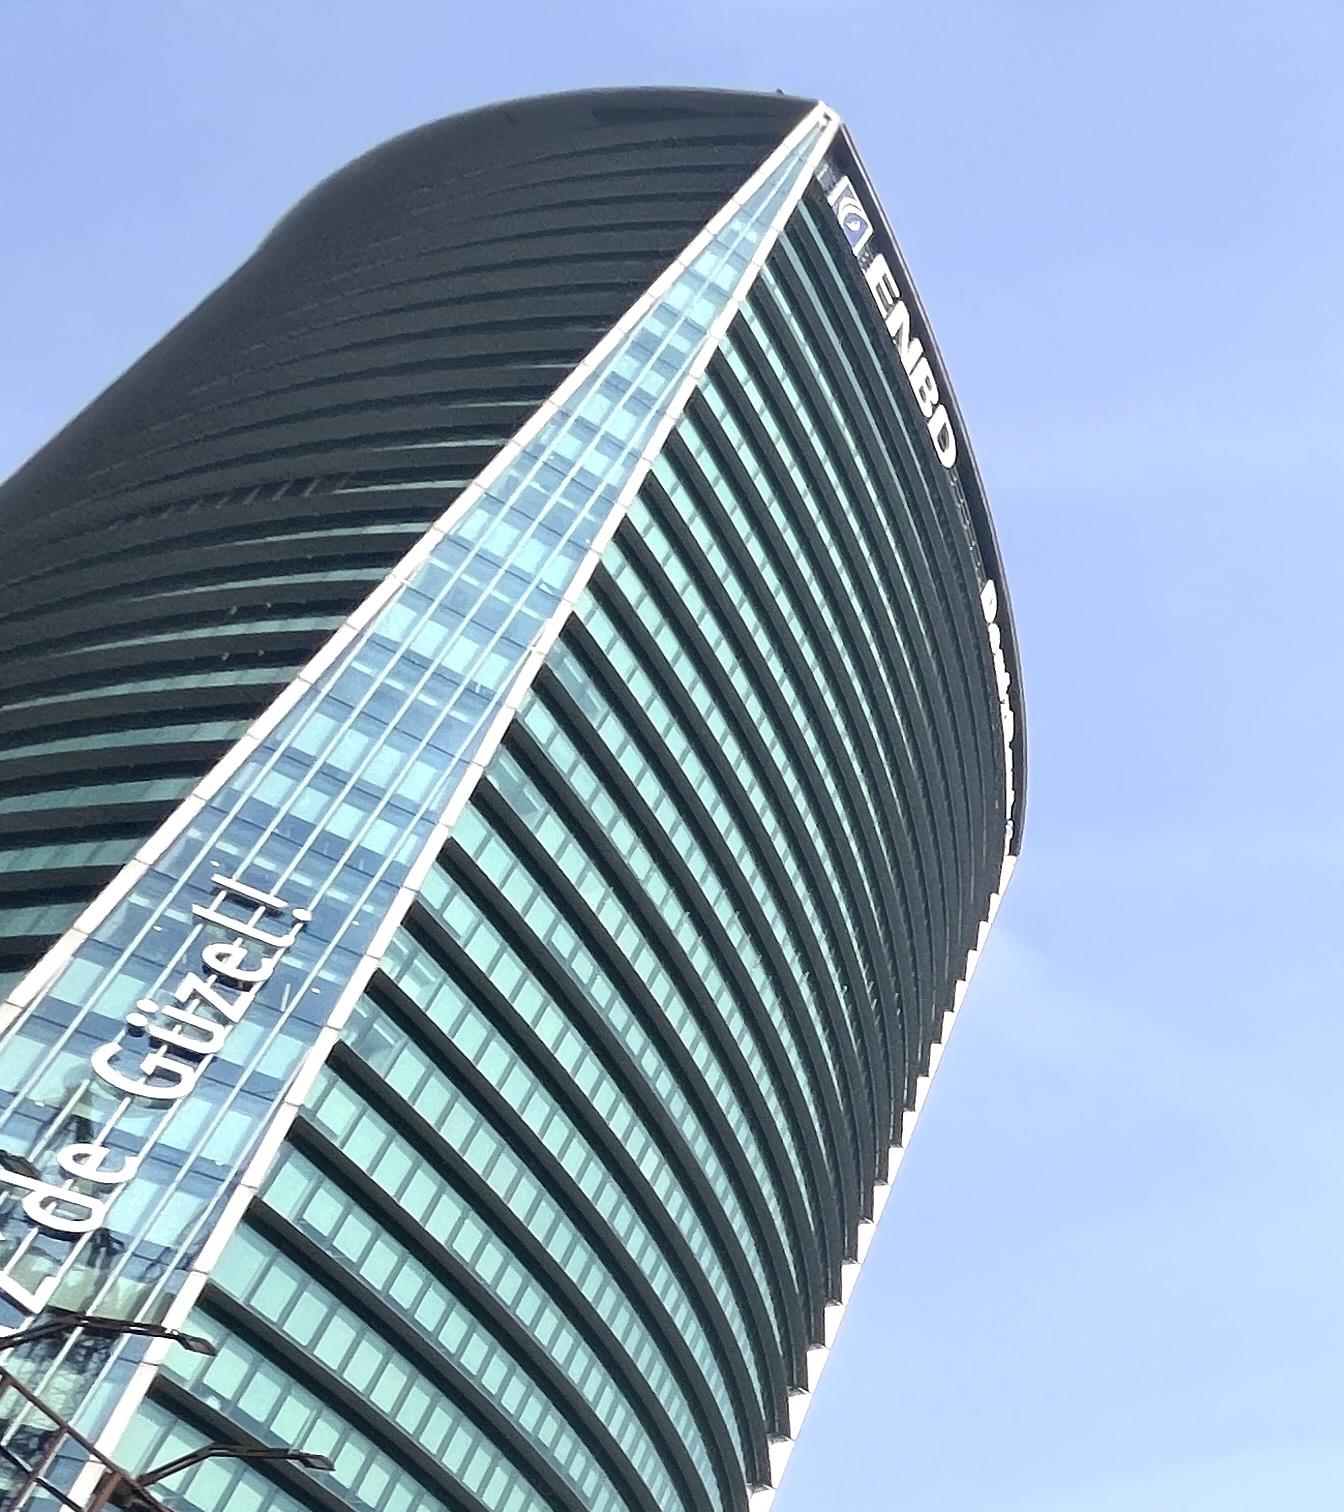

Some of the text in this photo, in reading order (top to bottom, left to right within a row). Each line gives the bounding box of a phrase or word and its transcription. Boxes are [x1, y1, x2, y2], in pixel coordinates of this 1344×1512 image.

[867, 252, 957, 468] ENBD
[0, 872, 313, 1235] de Güzel!
